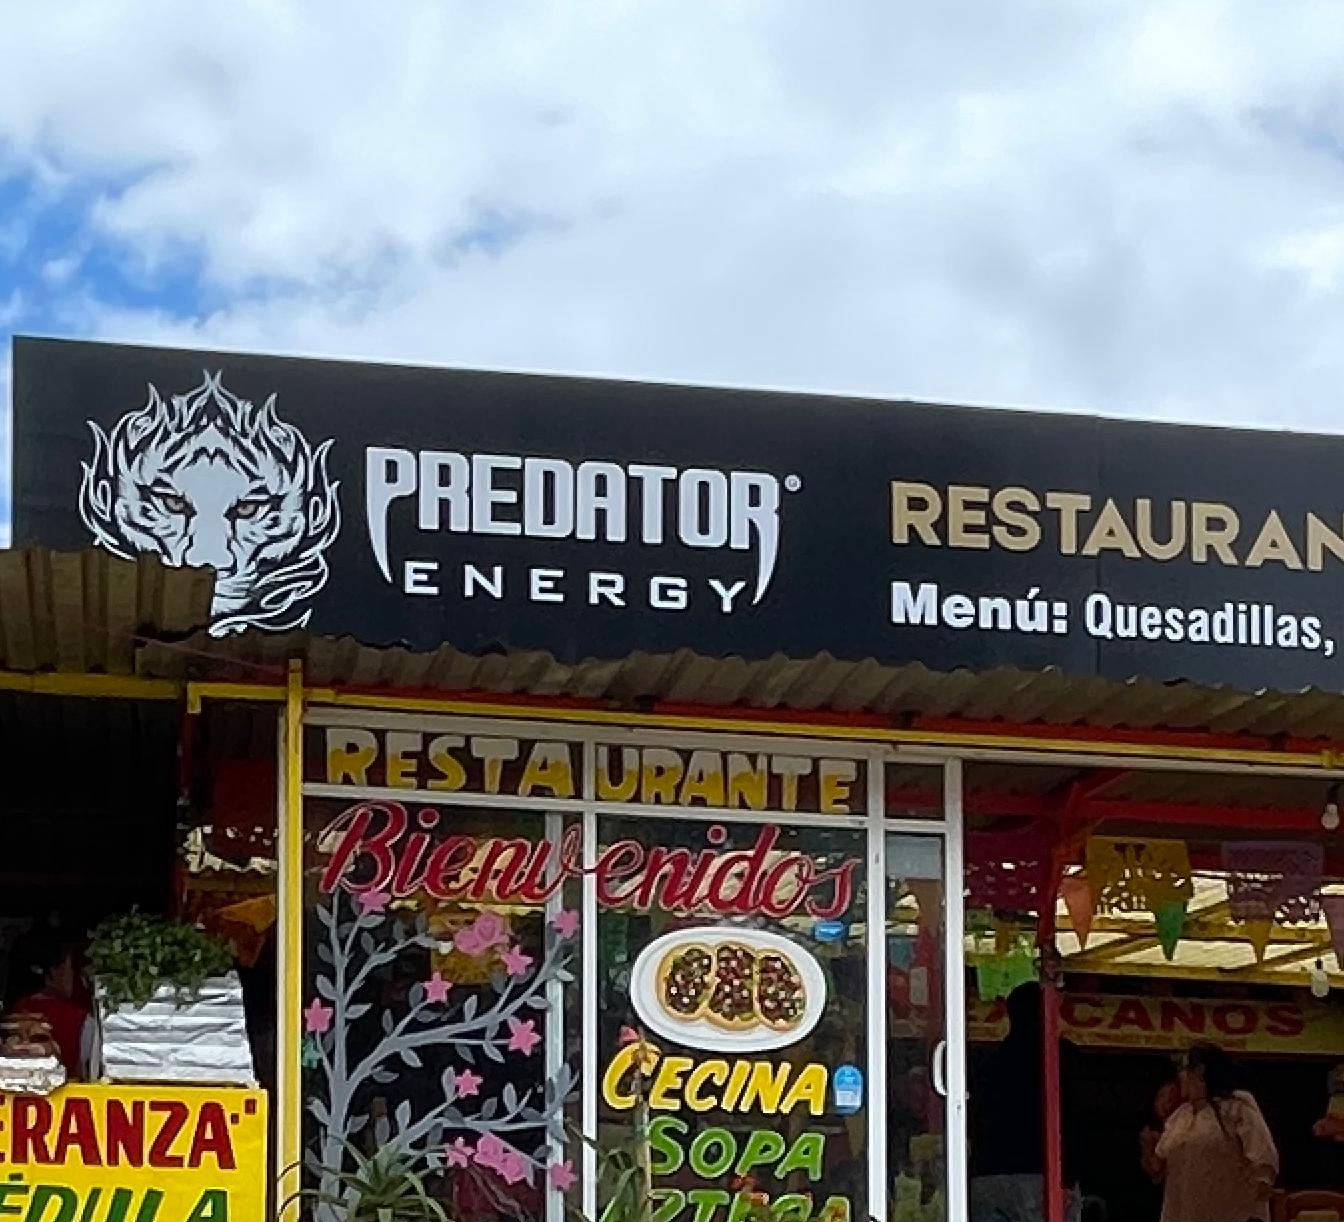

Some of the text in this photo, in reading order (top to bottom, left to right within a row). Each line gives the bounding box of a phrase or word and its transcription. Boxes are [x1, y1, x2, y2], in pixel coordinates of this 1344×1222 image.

[405, 563, 751, 613] ENERGY
[890, 581, 1069, 634] Menú:
[1085, 595, 1336, 657] Quesadillas,
[325, 728, 856, 815] RESTAURANTE
[317, 801, 861, 920] Bienvenidos
[602, 1042, 828, 1116] CECINA
[646, 1114, 826, 1181] SOPA
